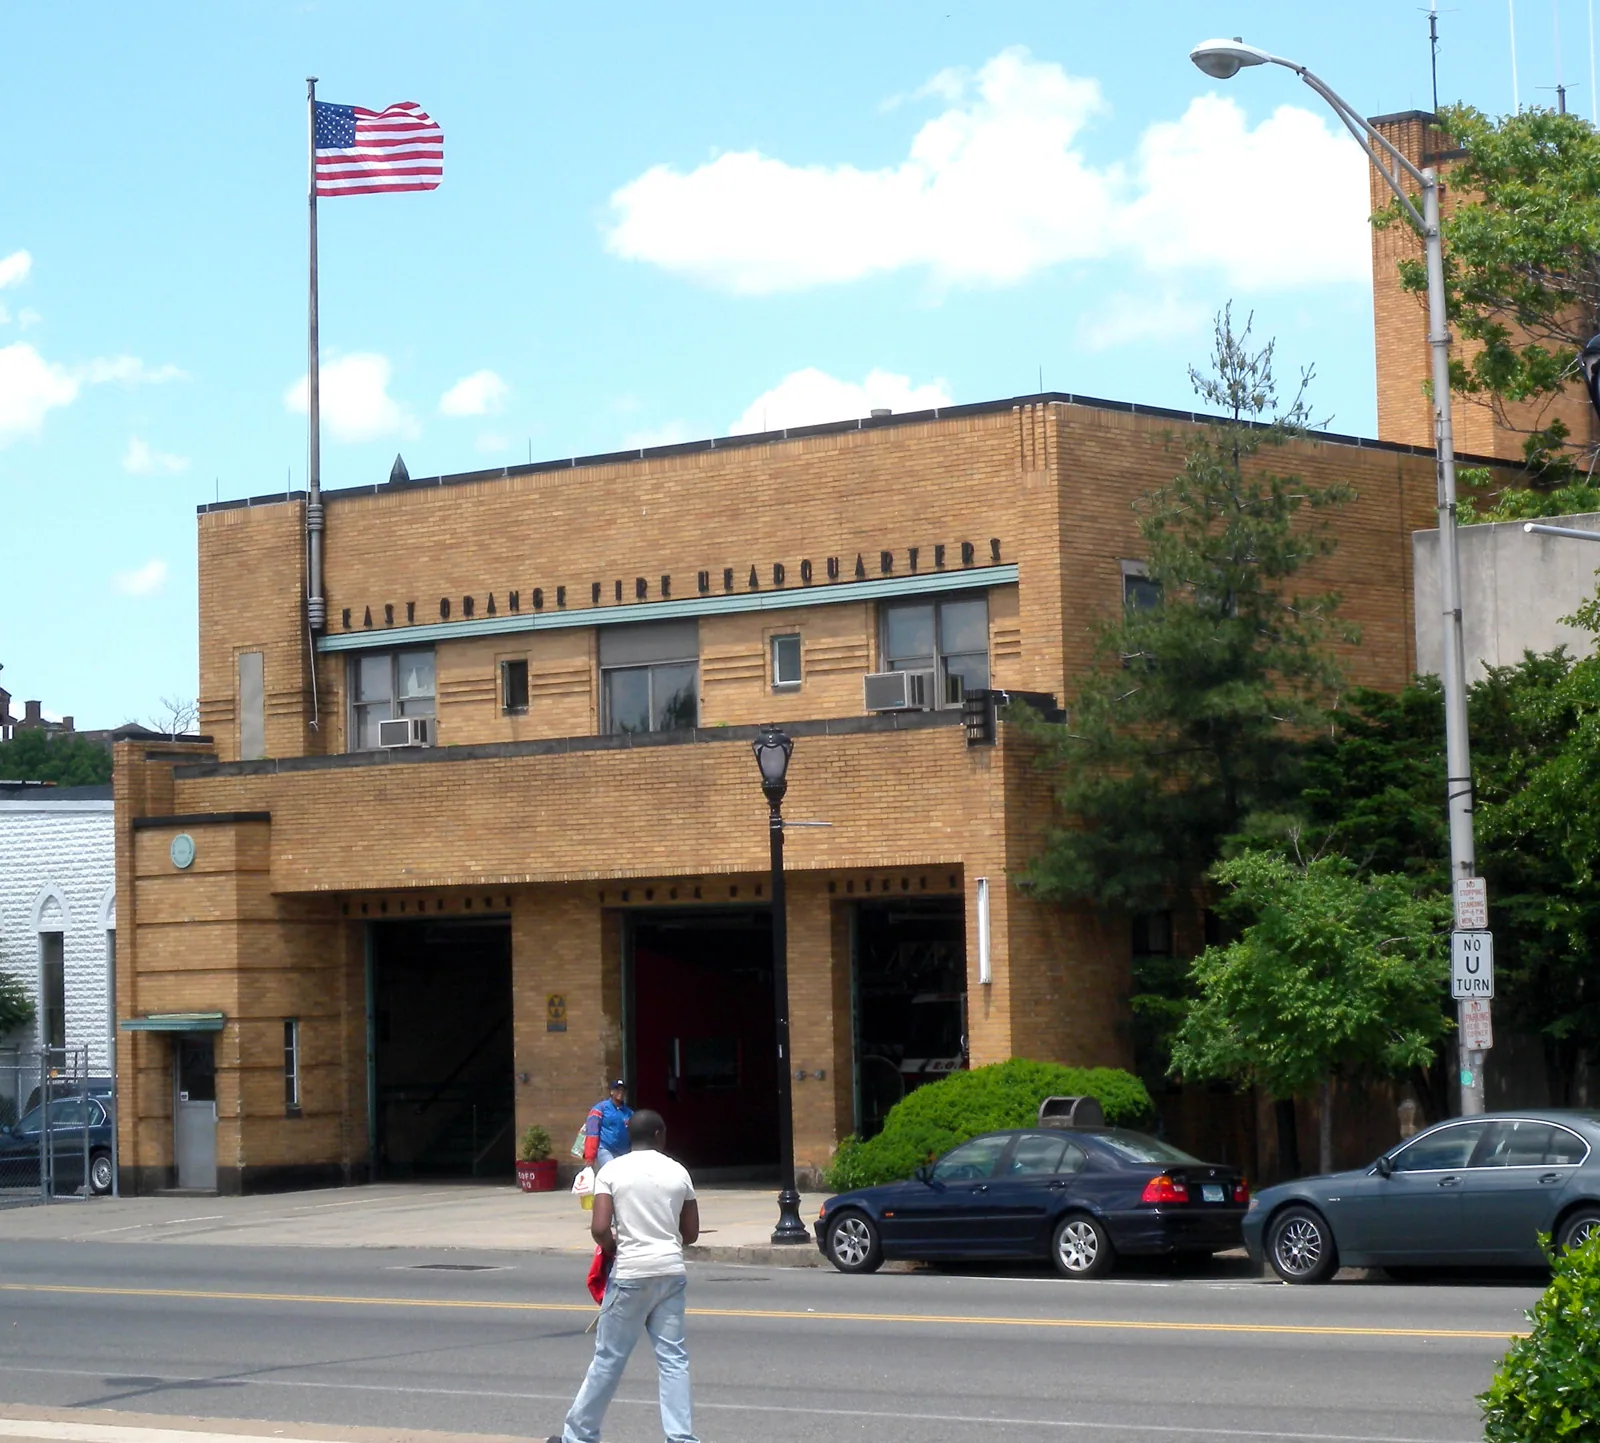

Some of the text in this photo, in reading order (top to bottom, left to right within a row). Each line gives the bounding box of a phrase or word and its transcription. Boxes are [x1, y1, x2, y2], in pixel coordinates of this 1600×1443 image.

[342, 538, 1001, 629] EAST ORANGE FIRE HEADQUARTERS
[1466, 881, 1475, 889] NO
[1464, 939, 1481, 951] NO
[1466, 956, 1479, 974] U
[1457, 979, 1489, 991] TURN
[1471, 1003, 1481, 1012] NO
[1465, 1012, 1489, 1022] PARKING
